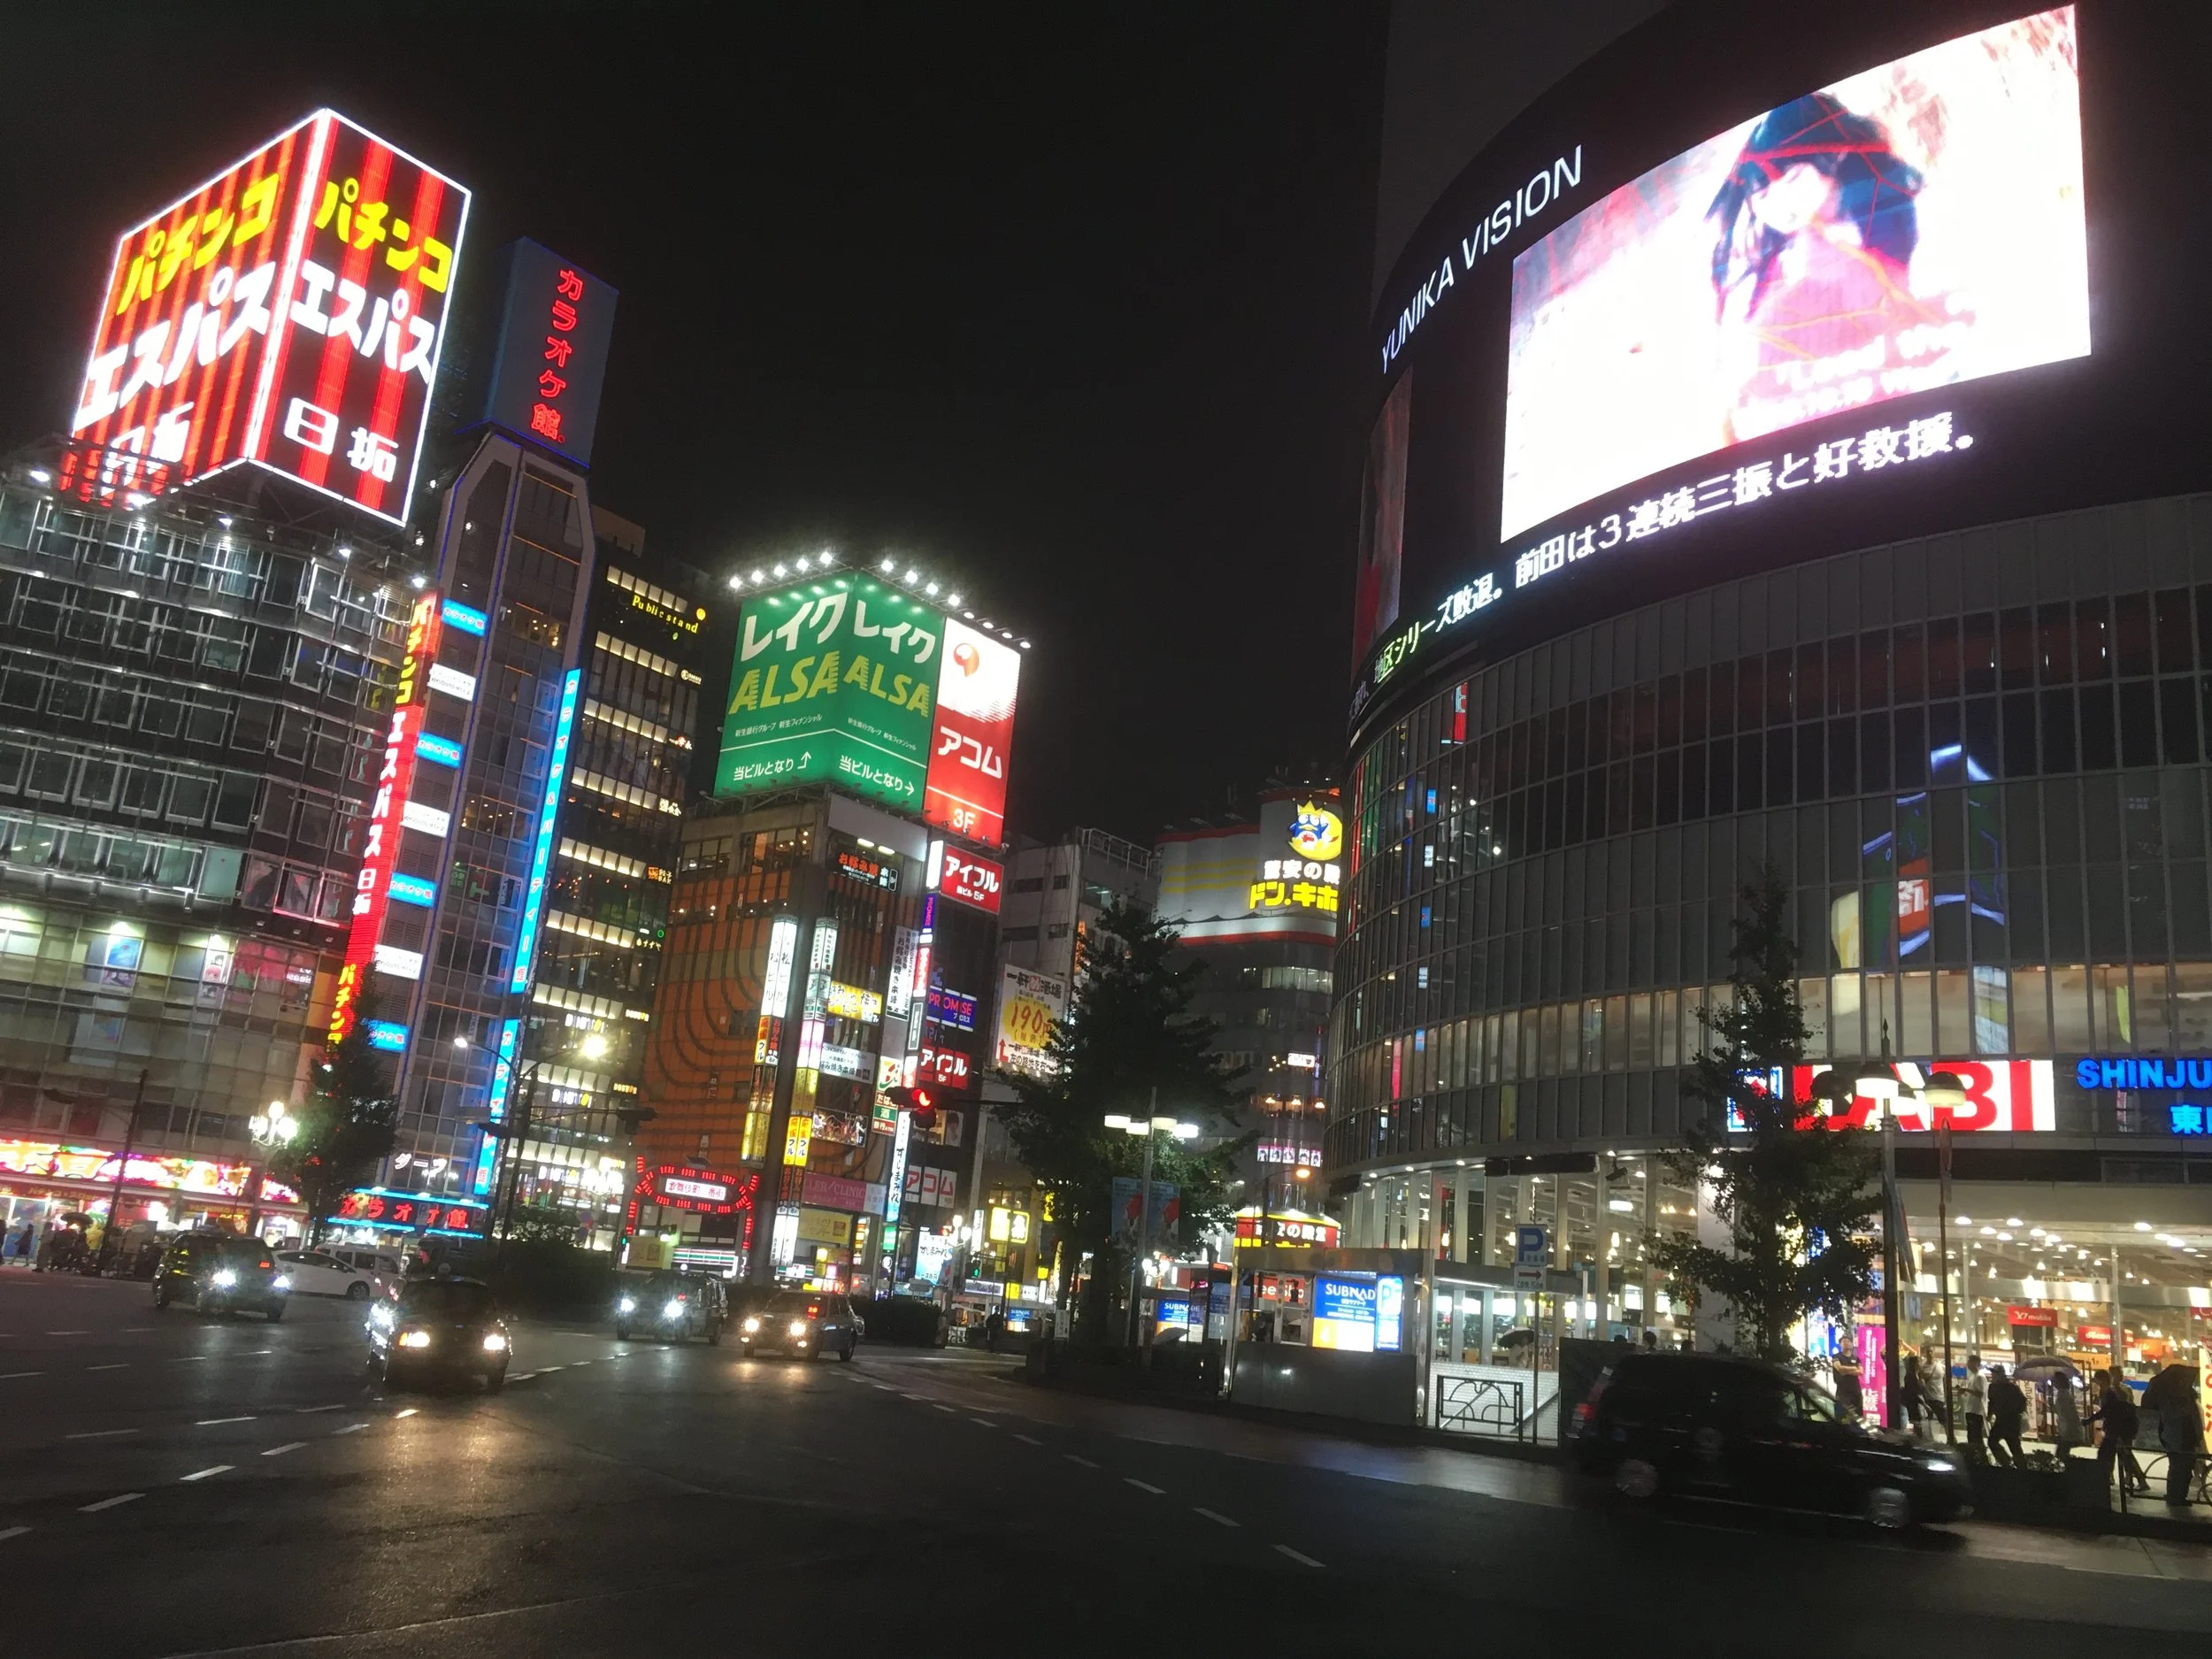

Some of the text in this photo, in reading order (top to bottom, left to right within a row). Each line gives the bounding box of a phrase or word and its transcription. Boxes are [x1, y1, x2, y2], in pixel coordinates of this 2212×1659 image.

[116, 172, 280, 317] パチンコ
[315, 177, 452, 293] パチンコ
[1382, 144, 1582, 374] YUNIKA VISION
[75, 261, 276, 426] エスパス
[290, 258, 434, 383] エスパス
[531, 268, 584, 443] カラオケ館
[283, 396, 398, 483] 日拓
[633, 595, 699, 634] Public stand
[741, 593, 848, 662] レイク
[854, 599, 936, 664] レイク
[396, 602, 434, 704] パチンコ
[728, 650, 841, 715] ALSA
[844, 655, 930, 718] ALSA
[733, 758, 794, 782] 当ビルとなり
[839, 755, 903, 791] 当ビルとなり
[938, 726, 1002, 779] アコム
[953, 809, 976, 829] 3F
[945, 856, 999, 893] アイフル
[973, 890, 985, 901] 5F
[2170, 1105, 2212, 1134] 東
[906, 1170, 954, 1196] アコム
[1519, 1228, 1543, 1262] P
